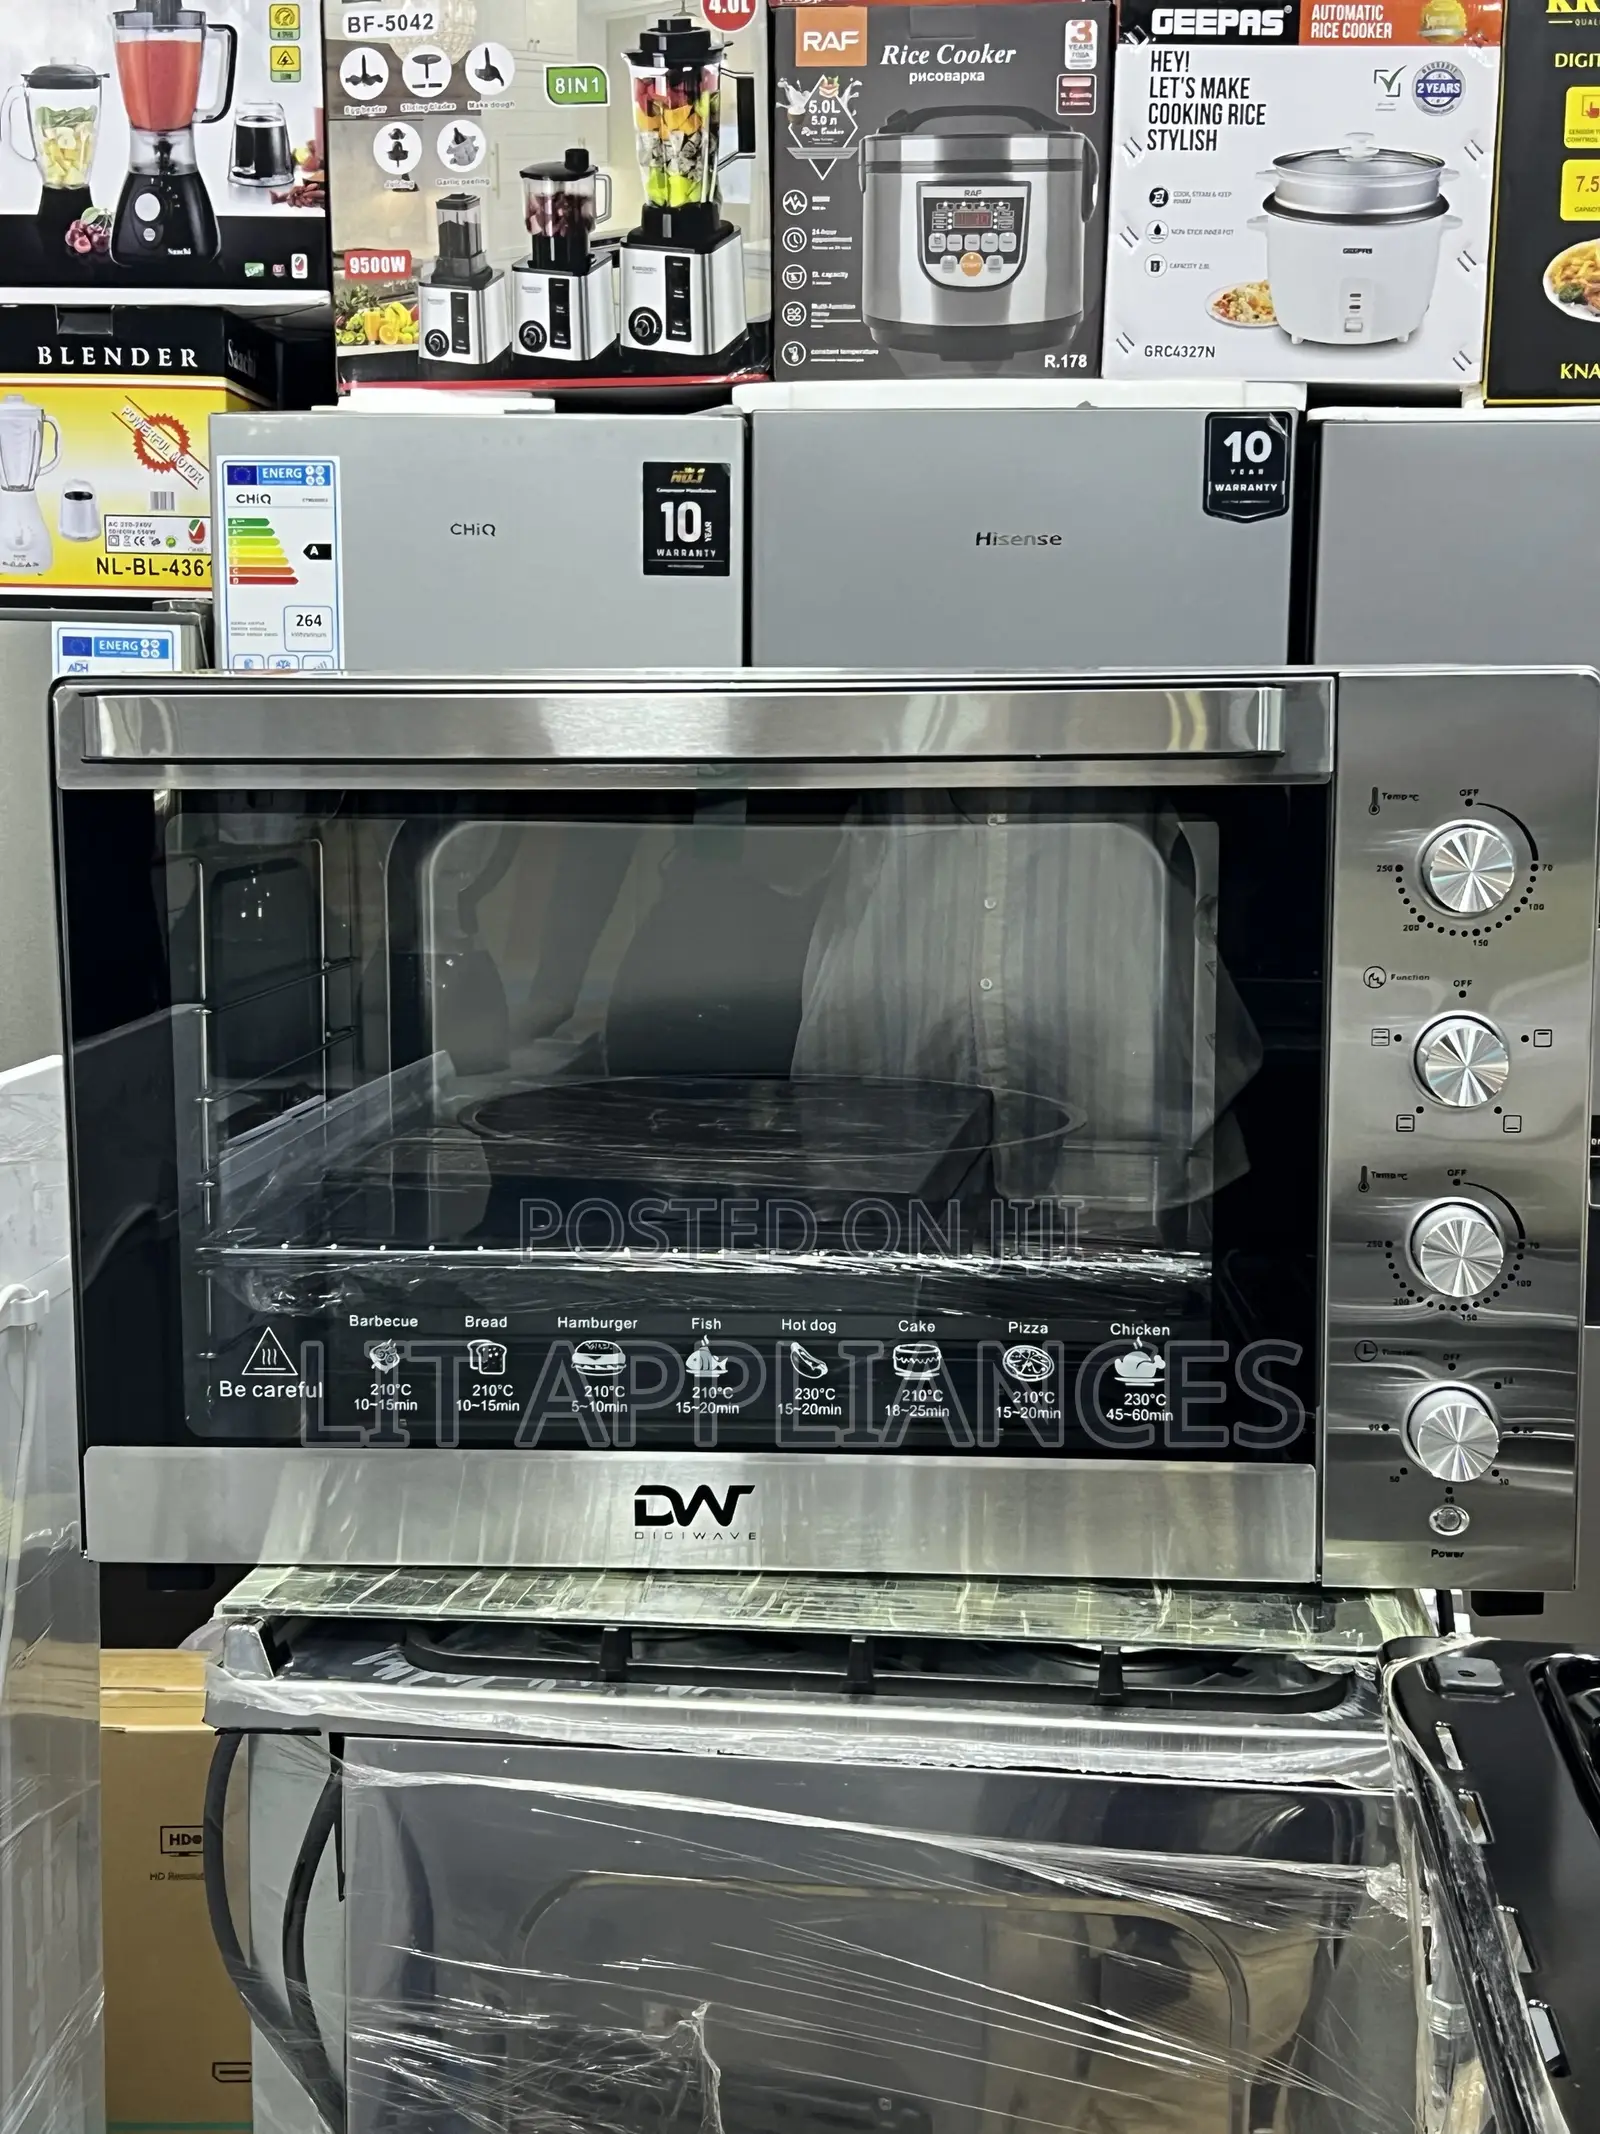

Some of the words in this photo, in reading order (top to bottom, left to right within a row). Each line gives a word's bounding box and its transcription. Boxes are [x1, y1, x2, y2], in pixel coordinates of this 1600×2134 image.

[1312, 4, 1384, 21] AUTOMATIC
[347, 13, 434, 33] BF-5042
[1152, 9, 1283, 35] GEEPAS
[1071, 20, 1092, 43] 3
[1311, 22, 1339, 38] RICE
[1342, 22, 1392, 38] COOKER
[803, 31, 860, 51] RAF
[880, 45, 930, 65] Rice
[936, 43, 1017, 64] Cooker
[1151, 50, 1190, 72] HEY!
[909, 71, 985, 85] рисоварка
[555, 77, 600, 94] 8IN1
[1150, 77, 1196, 99] LET'S
[1200, 77, 1250, 99] MAKE
[1417, 83, 1424, 93] 2
[1426, 83, 1461, 93] YEARS
[809, 100, 841, 114] 5.0L
[811, 115, 827, 126] 5.0
[1148, 103, 1223, 125] COOKING
[1228, 104, 1267, 125] RICE
[1147, 129, 1218, 151] STYLISH
[349, 256, 406, 275] 9500W
[37, 346, 198, 367] BLENDER
[1144, 345, 1216, 359] GRC4327N
[1045, 355, 1088, 368] R.178
[1561, 363, 1600, 379] KNA
[121, 405, 170, 457] POWERFUL
[169, 452, 205, 485] MOTOR
[1223, 430, 1272, 463] 10
[262, 467, 302, 479] ENERG
[1214, 483, 1278, 492] WARRANTY
[236, 494, 271, 505] CHiQ
[660, 501, 702, 543] 10
[450, 523, 496, 537] CHiQ
[976, 531, 1062, 546] Hisense
[310, 546, 319, 556] A
[656, 549, 717, 558] WARRANTY
[97, 557, 212, 576] NL-BL-436
[296, 614, 322, 627] 264
[99, 640, 138, 651] ENERG
[1459, 789, 1479, 797] OFF
[1376, 864, 1393, 872] 250
[1529, 903, 1545, 911] 100
[1403, 924, 1420, 932] 200
[1473, 939, 1489, 947] 150
[1391, 973, 1430, 981] Function
[1453, 980, 1473, 988] OFF
[1447, 1169, 1467, 1177] OFF
[349, 1315, 419, 1328] Barbecue
[465, 1316, 507, 1328] Bread
[557, 1317, 638, 1331] Hamburger
[691, 1318, 722, 1330] Fish
[781, 1319, 807, 1331] Hot
[811, 1319, 837, 1333] dog
[898, 1320, 935, 1333] Cake
[1008, 1321, 1049, 1334] Pizza
[1110, 1323, 1170, 1336] Chicken
[219, 1381, 246, 1397] Be
[252, 1381, 324, 1399] careful
[371, 1384, 412, 1396] 210°C
[472, 1384, 514, 1397] 210°C
[584, 1385, 625, 1398] 210°C
[692, 1386, 733, 1399] 210°C
[794, 1387, 836, 1400] 230°C
[902, 1389, 944, 1402] 210°C
[1013, 1391, 1055, 1404] 210°C
[1124, 1393, 1167, 1406] 230°C
[456, 1399, 520, 1412] 10~15min
[571, 1401, 628, 1413] 5~10min
[676, 1402, 740, 1414] 15~20min
[777, 1403, 842, 1416] 15~20min
[996, 1406, 1061, 1420] 15~20min
[1106, 1408, 1173, 1422] 45~60min
[634, 1531, 757, 1541] DIGIWAVE
[1431, 1549, 1465, 1558] Power
